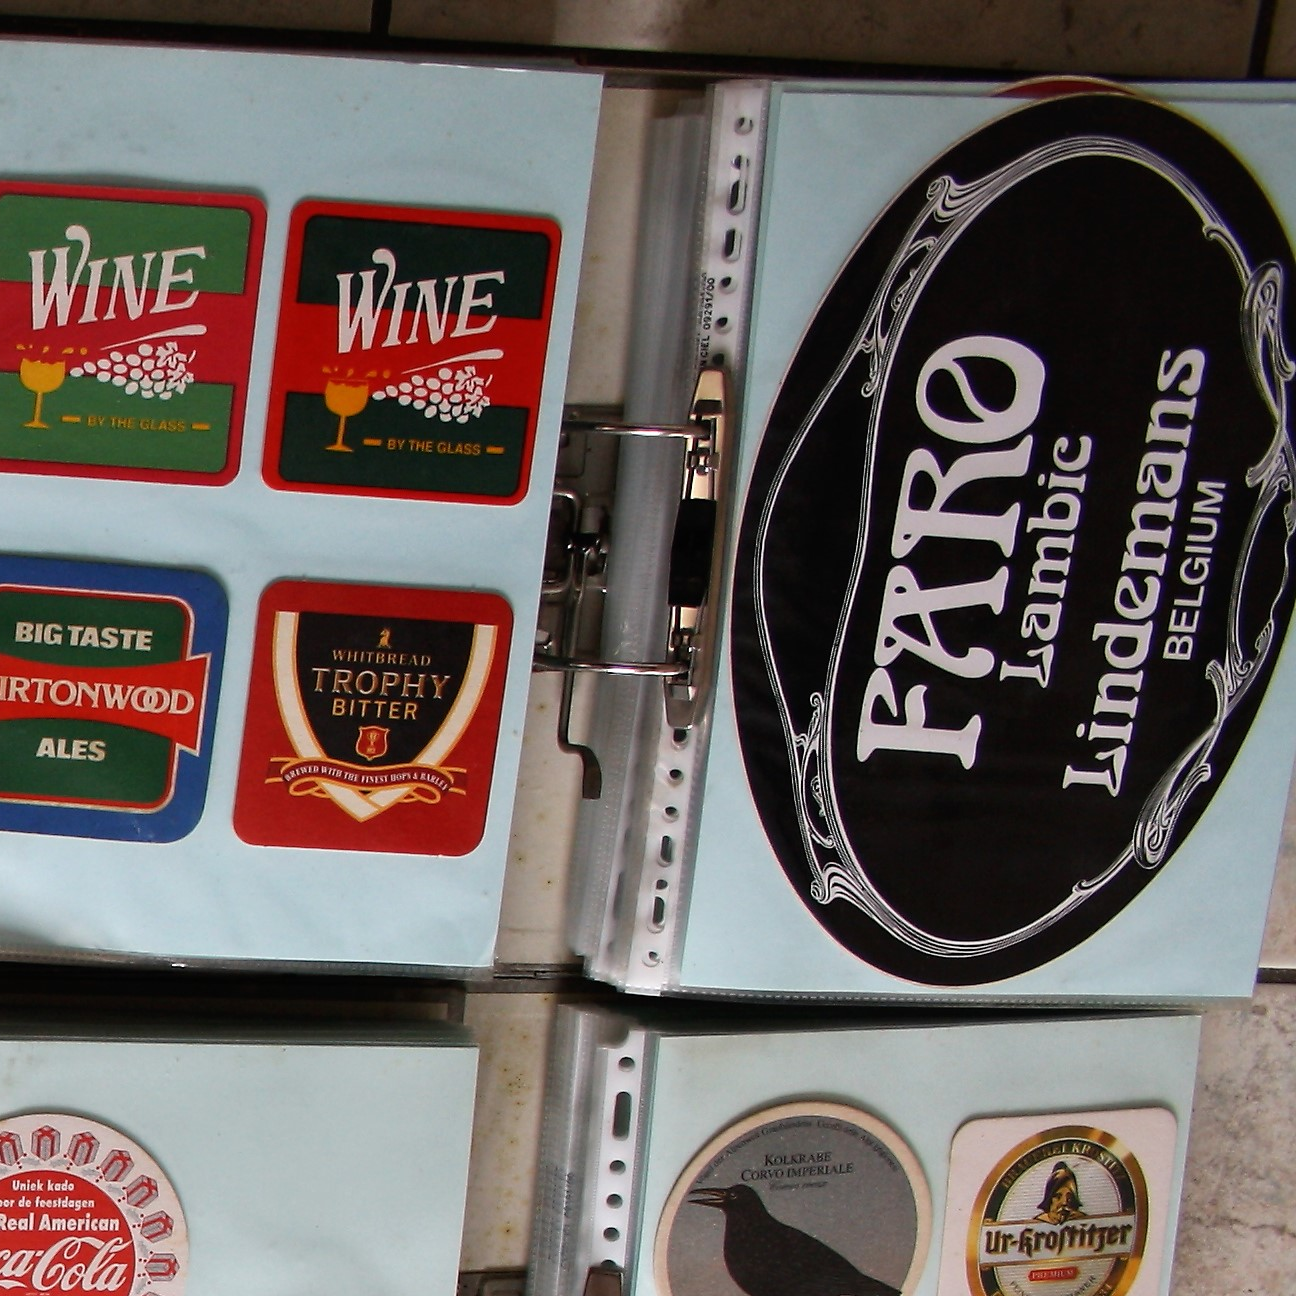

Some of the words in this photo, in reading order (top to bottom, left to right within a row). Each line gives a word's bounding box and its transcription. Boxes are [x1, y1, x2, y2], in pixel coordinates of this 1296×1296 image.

[28, 224, 207, 330] WINE
[336, 248, 505, 353] WINE
[998, 433, 1094, 690] Lambic
[1060, 345, 1209, 798] Lindemans
[1163, 477, 1227, 662] BELGIUM
[15, 621, 63, 645] BIG
[67, 625, 153, 651] TASTE
[332, 649, 431, 667] WHITBREAD
[312, 667, 450, 699] TROPHY
[332, 699, 417, 720] BITTER
[36, 737, 107, 762] ALES
[321, 765, 342, 778] WITH
[12, 1180, 44, 1192] Uniek
[47, 1180, 75, 1191] kado
[18, 1197, 32, 1208] de
[35, 1198, 94, 1211] feestdagen
[38, 1213, 119, 1232] American
